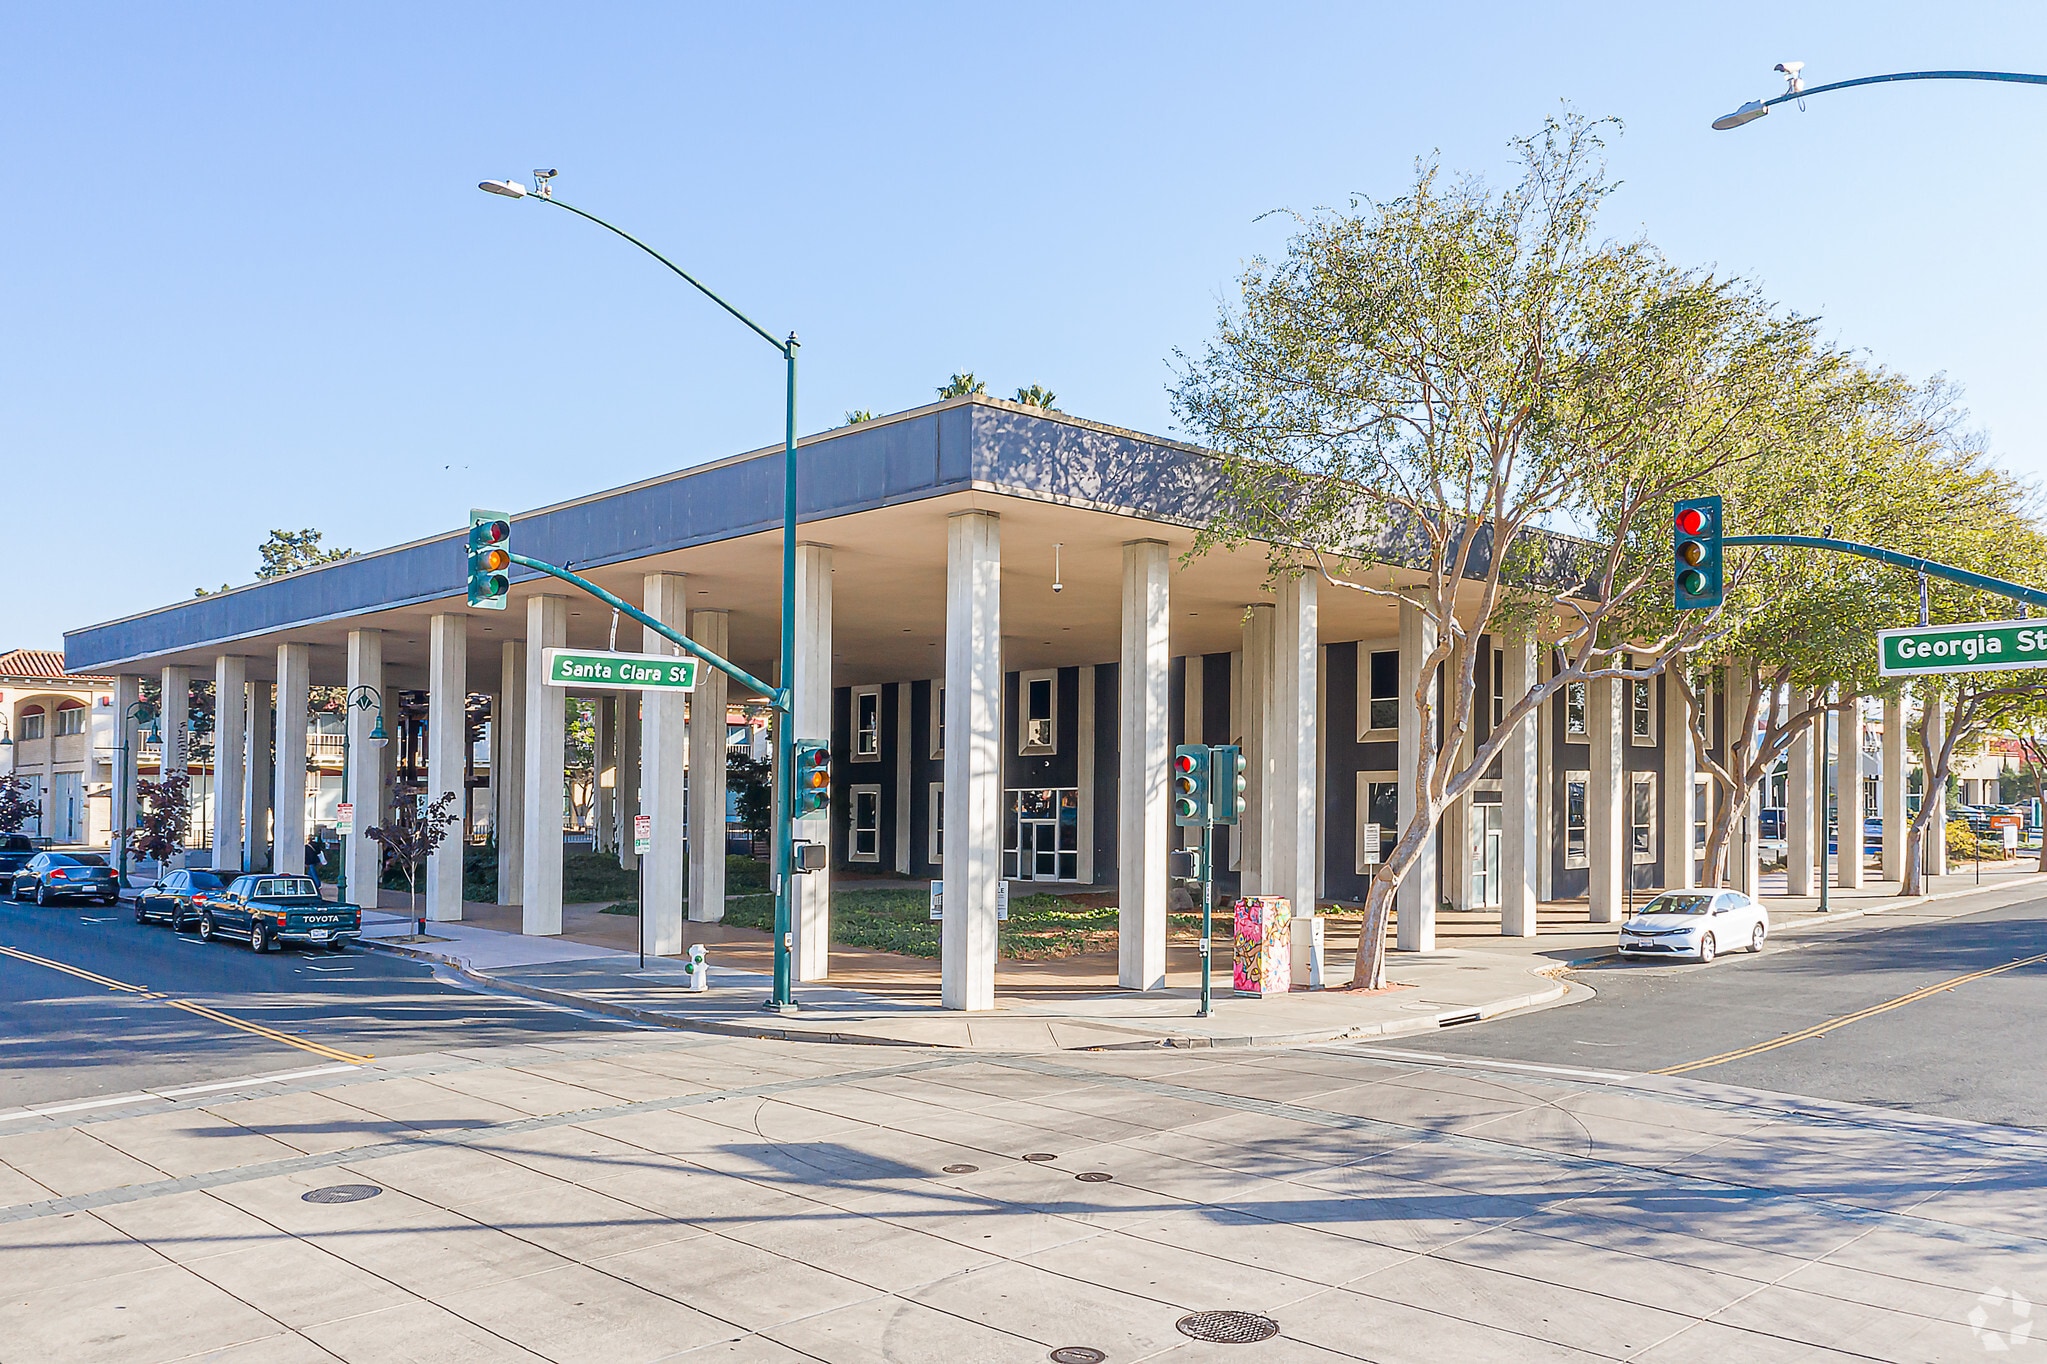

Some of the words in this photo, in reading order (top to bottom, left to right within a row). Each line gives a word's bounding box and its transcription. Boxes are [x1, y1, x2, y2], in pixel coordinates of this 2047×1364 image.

[1897, 633, 2002, 662] Georgia
[2016, 629, 2047, 652] St
[560, 660, 612, 679] Santa
[619, 663, 662, 681] Clara
[668, 666, 687, 683] St
[302, 915, 340, 923] TOYOTA
